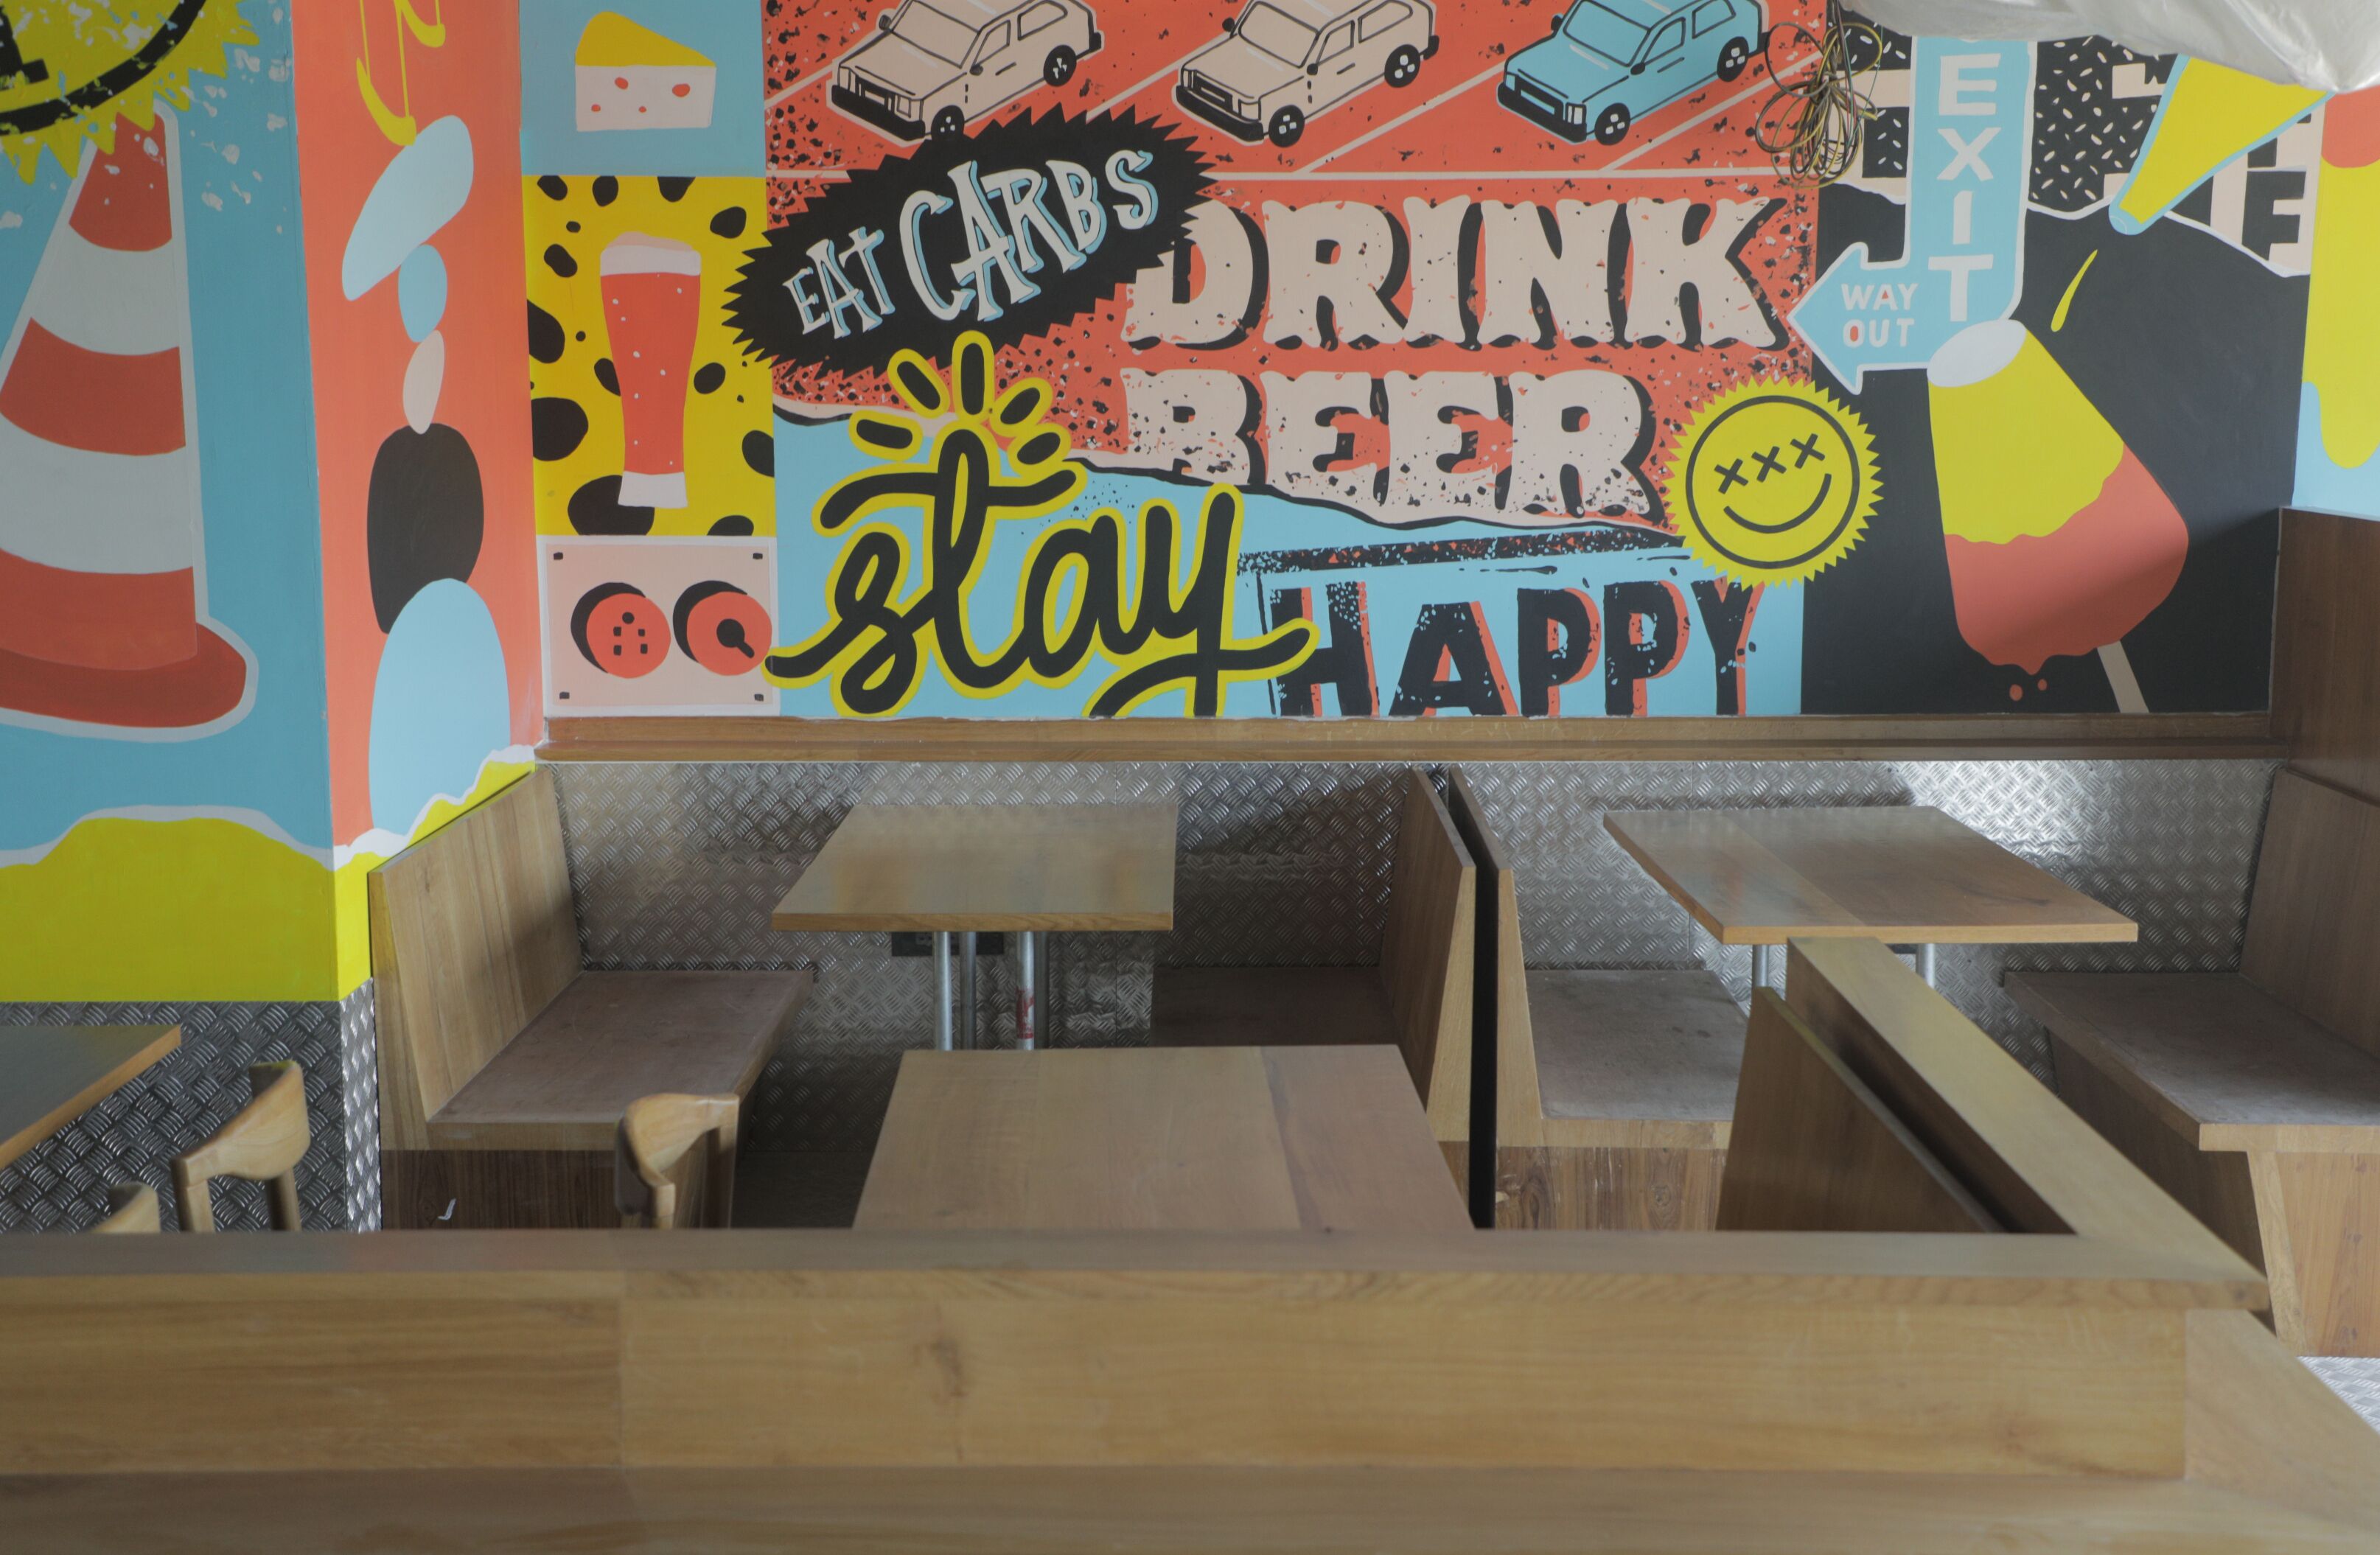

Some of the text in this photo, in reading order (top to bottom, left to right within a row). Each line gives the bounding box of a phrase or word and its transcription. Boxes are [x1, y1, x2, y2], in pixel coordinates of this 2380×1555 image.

[899, 150, 1159, 322] CARBS
[1927, 53, 2002, 322] EXIT
[1120, 195, 1791, 352] DRINK
[1840, 282, 1919, 311] WAY
[1843, 318, 1915, 348] OUT
[1120, 367, 1666, 523] BEER
[1266, 579, 1765, 717] HAPPY
